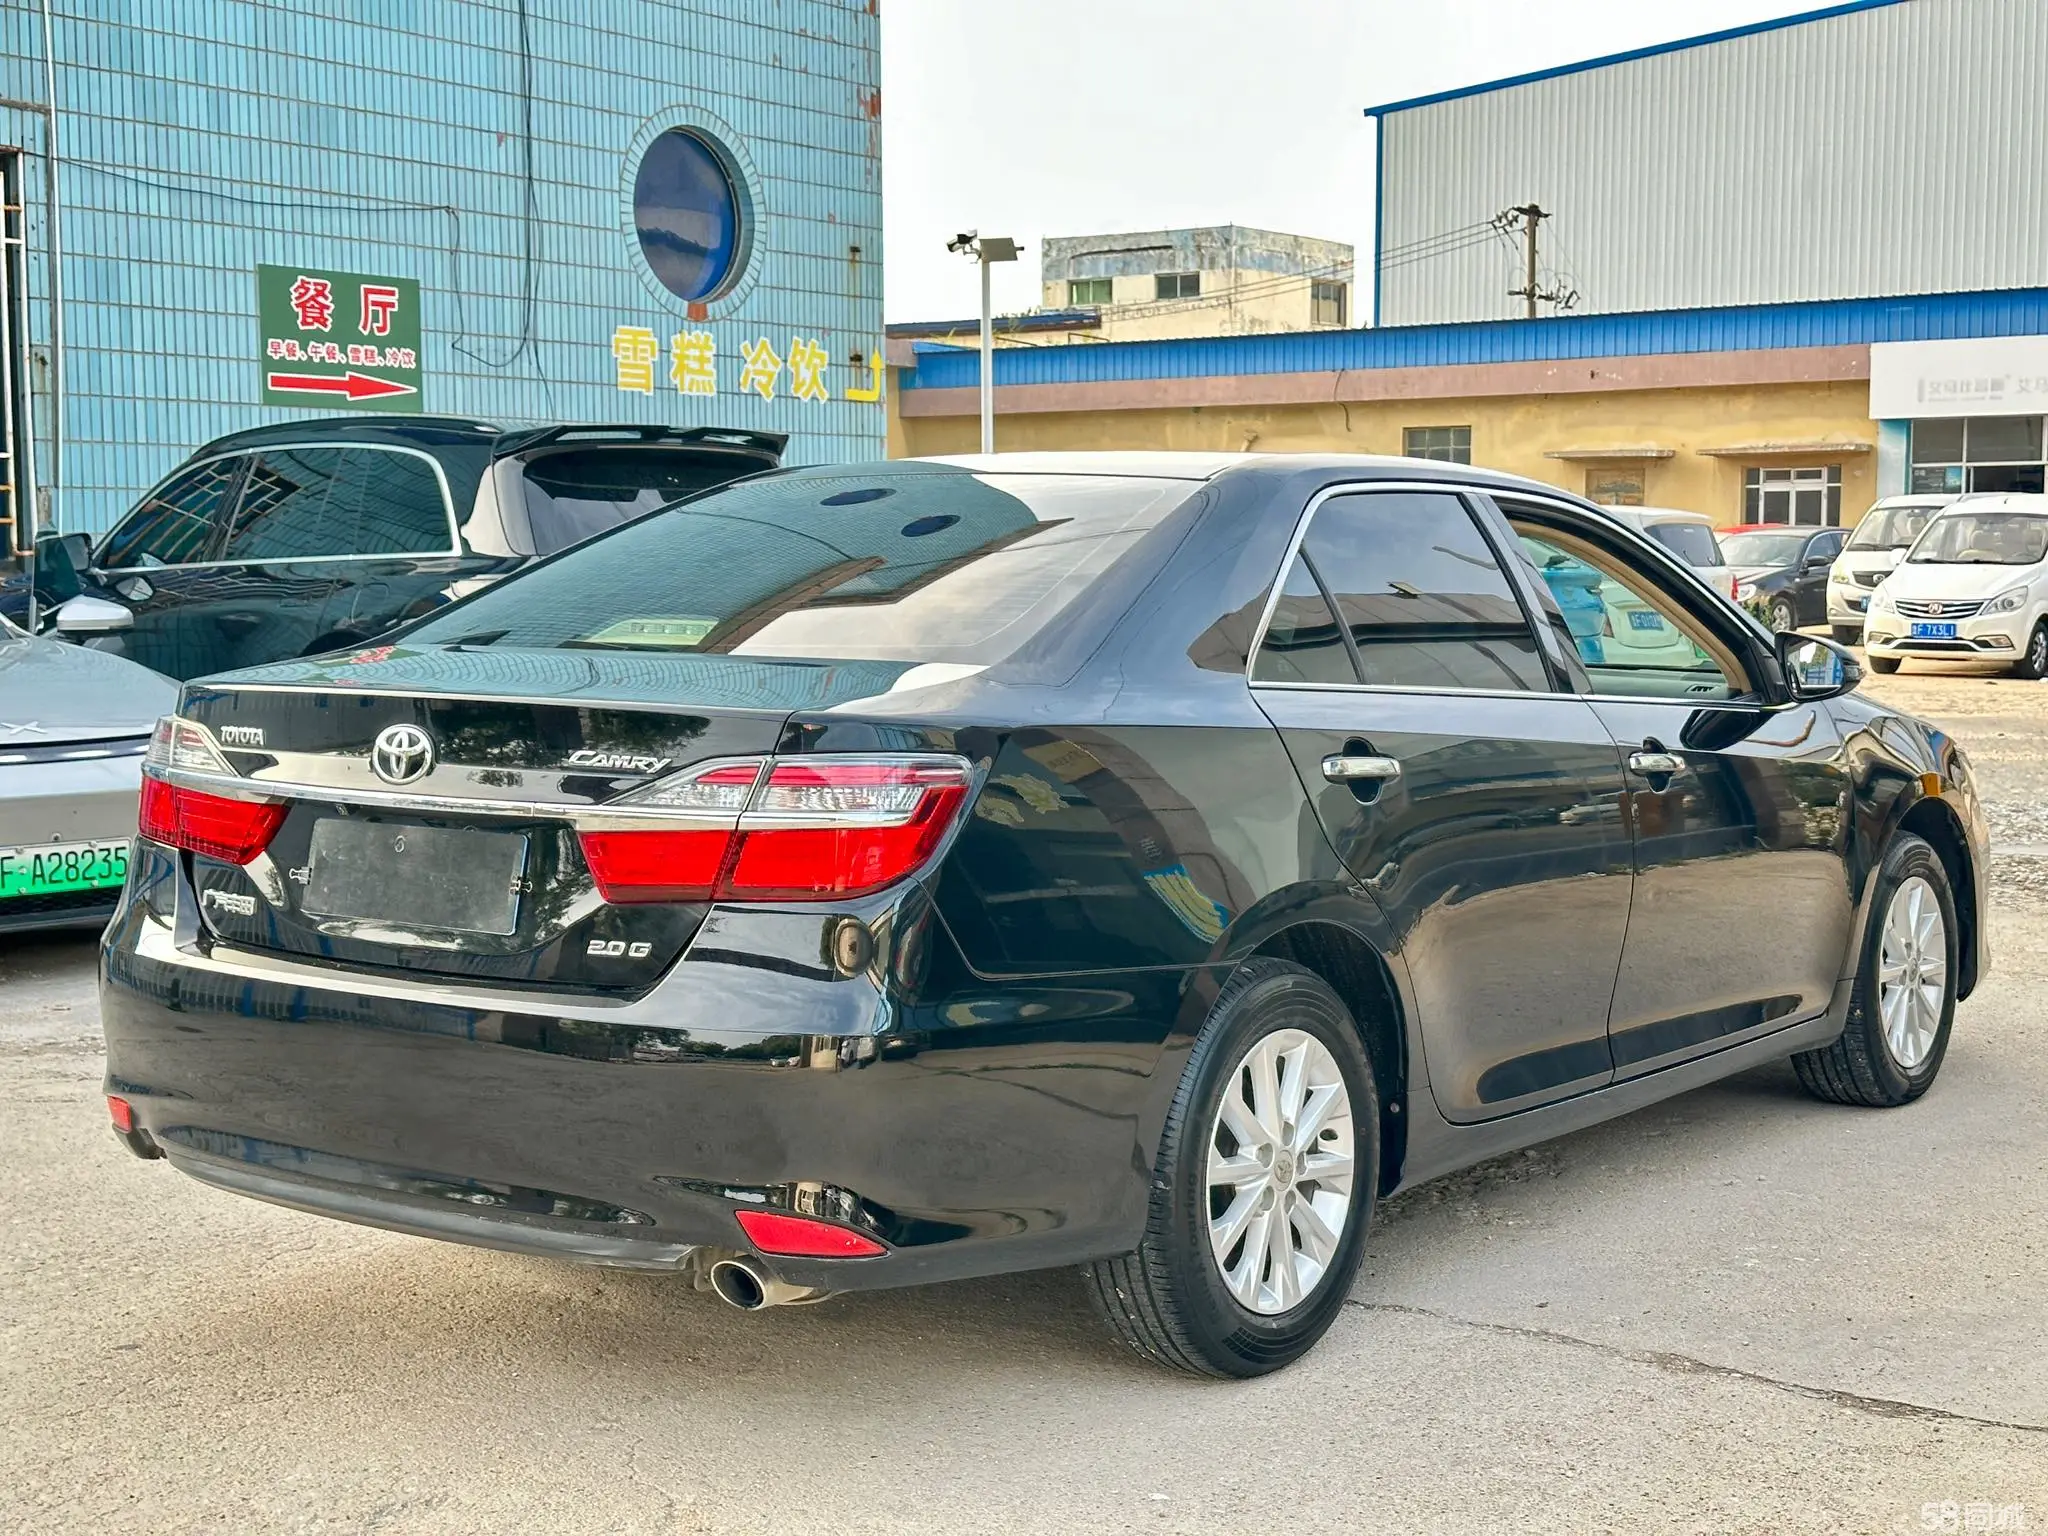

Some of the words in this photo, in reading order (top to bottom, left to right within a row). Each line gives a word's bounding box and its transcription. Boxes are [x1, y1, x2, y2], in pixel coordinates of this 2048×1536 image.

[290, 275, 399, 335] 餐厅
[612, 324, 717, 396] 雪糕
[738, 335, 829, 404] 冷饮
[220, 726, 264, 745] TOYOTA
[568, 750, 672, 773] CAMRY
